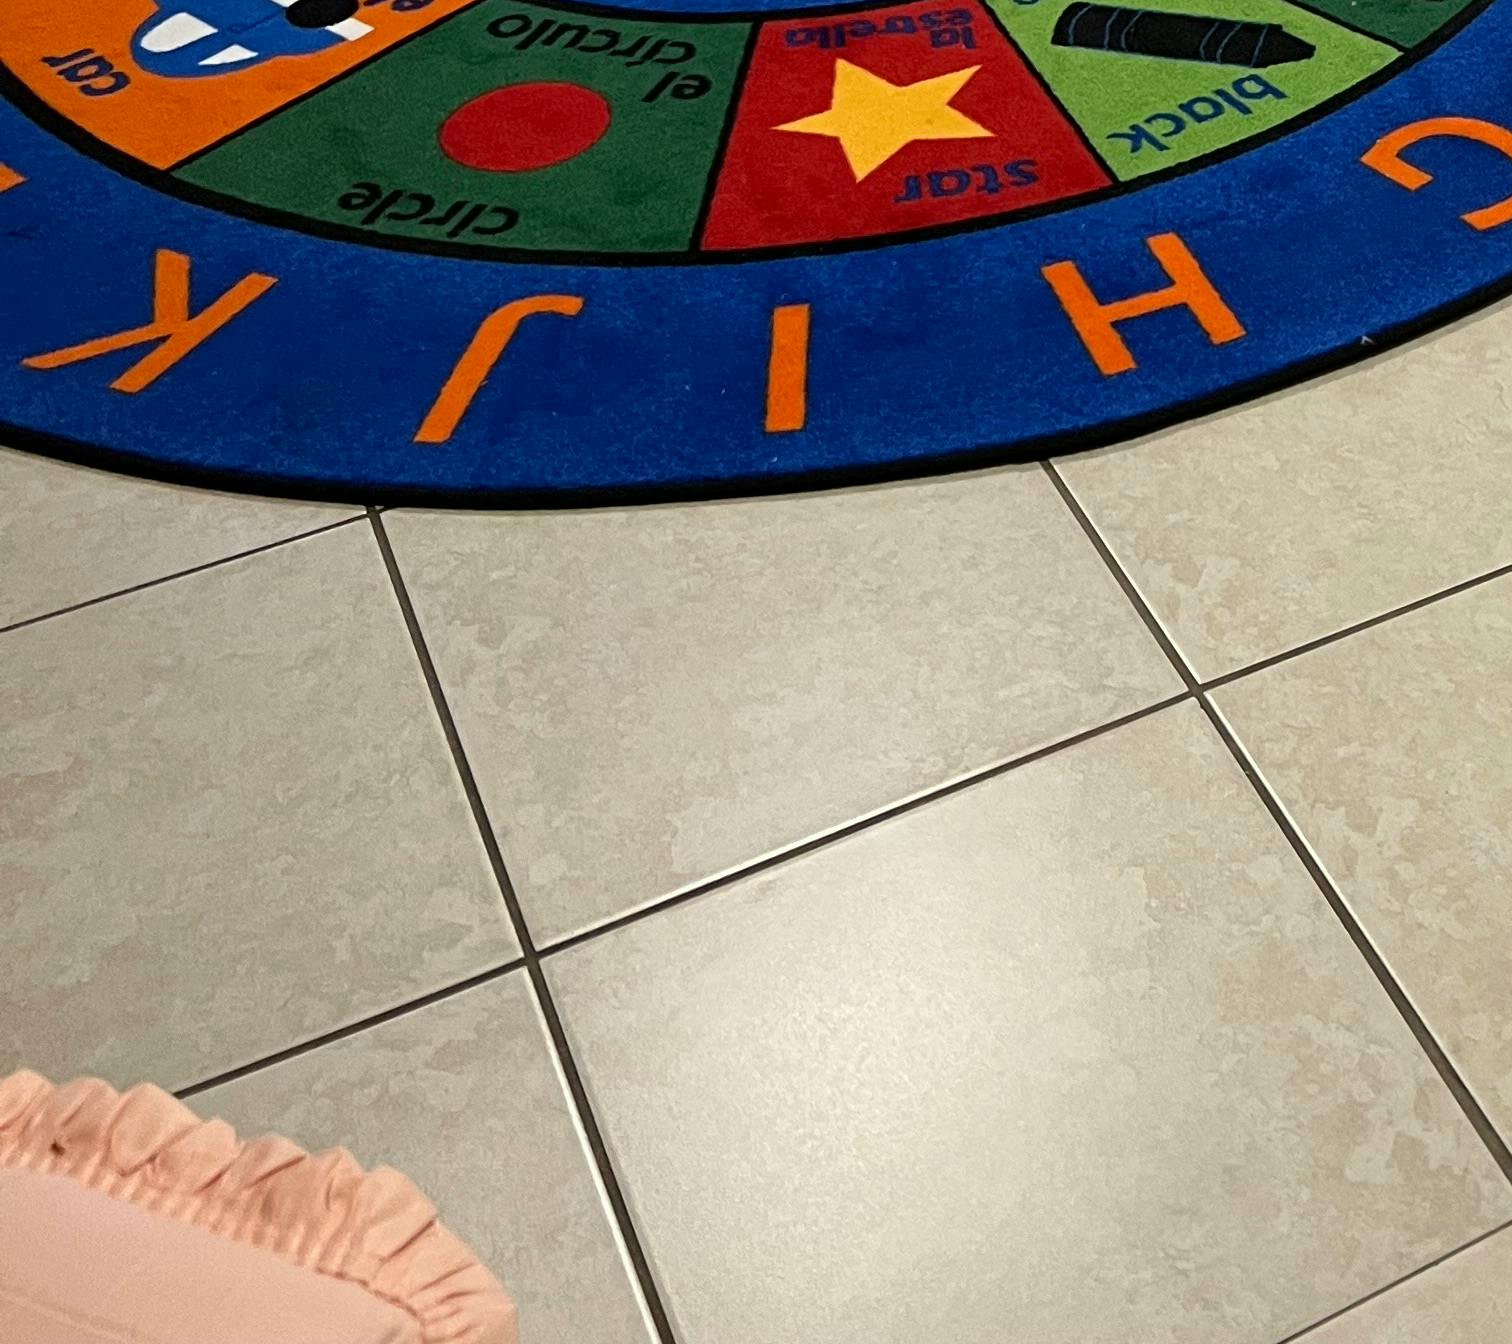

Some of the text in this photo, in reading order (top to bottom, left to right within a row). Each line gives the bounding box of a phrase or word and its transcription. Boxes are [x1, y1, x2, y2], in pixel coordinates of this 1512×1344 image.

[784, 7, 973, 50] estrella
[930, 25, 978, 50] la
[41, 47, 131, 98] car
[641, 70, 713, 103] el
[1106, 73, 1288, 156] black
[336, 181, 520, 239] circle
[892, 159, 1040, 205] star
[20, 248, 279, 394] K
[1040, 231, 1248, 378] H
[412, 293, 586, 445] J
[764, 303, 811, 433] I
